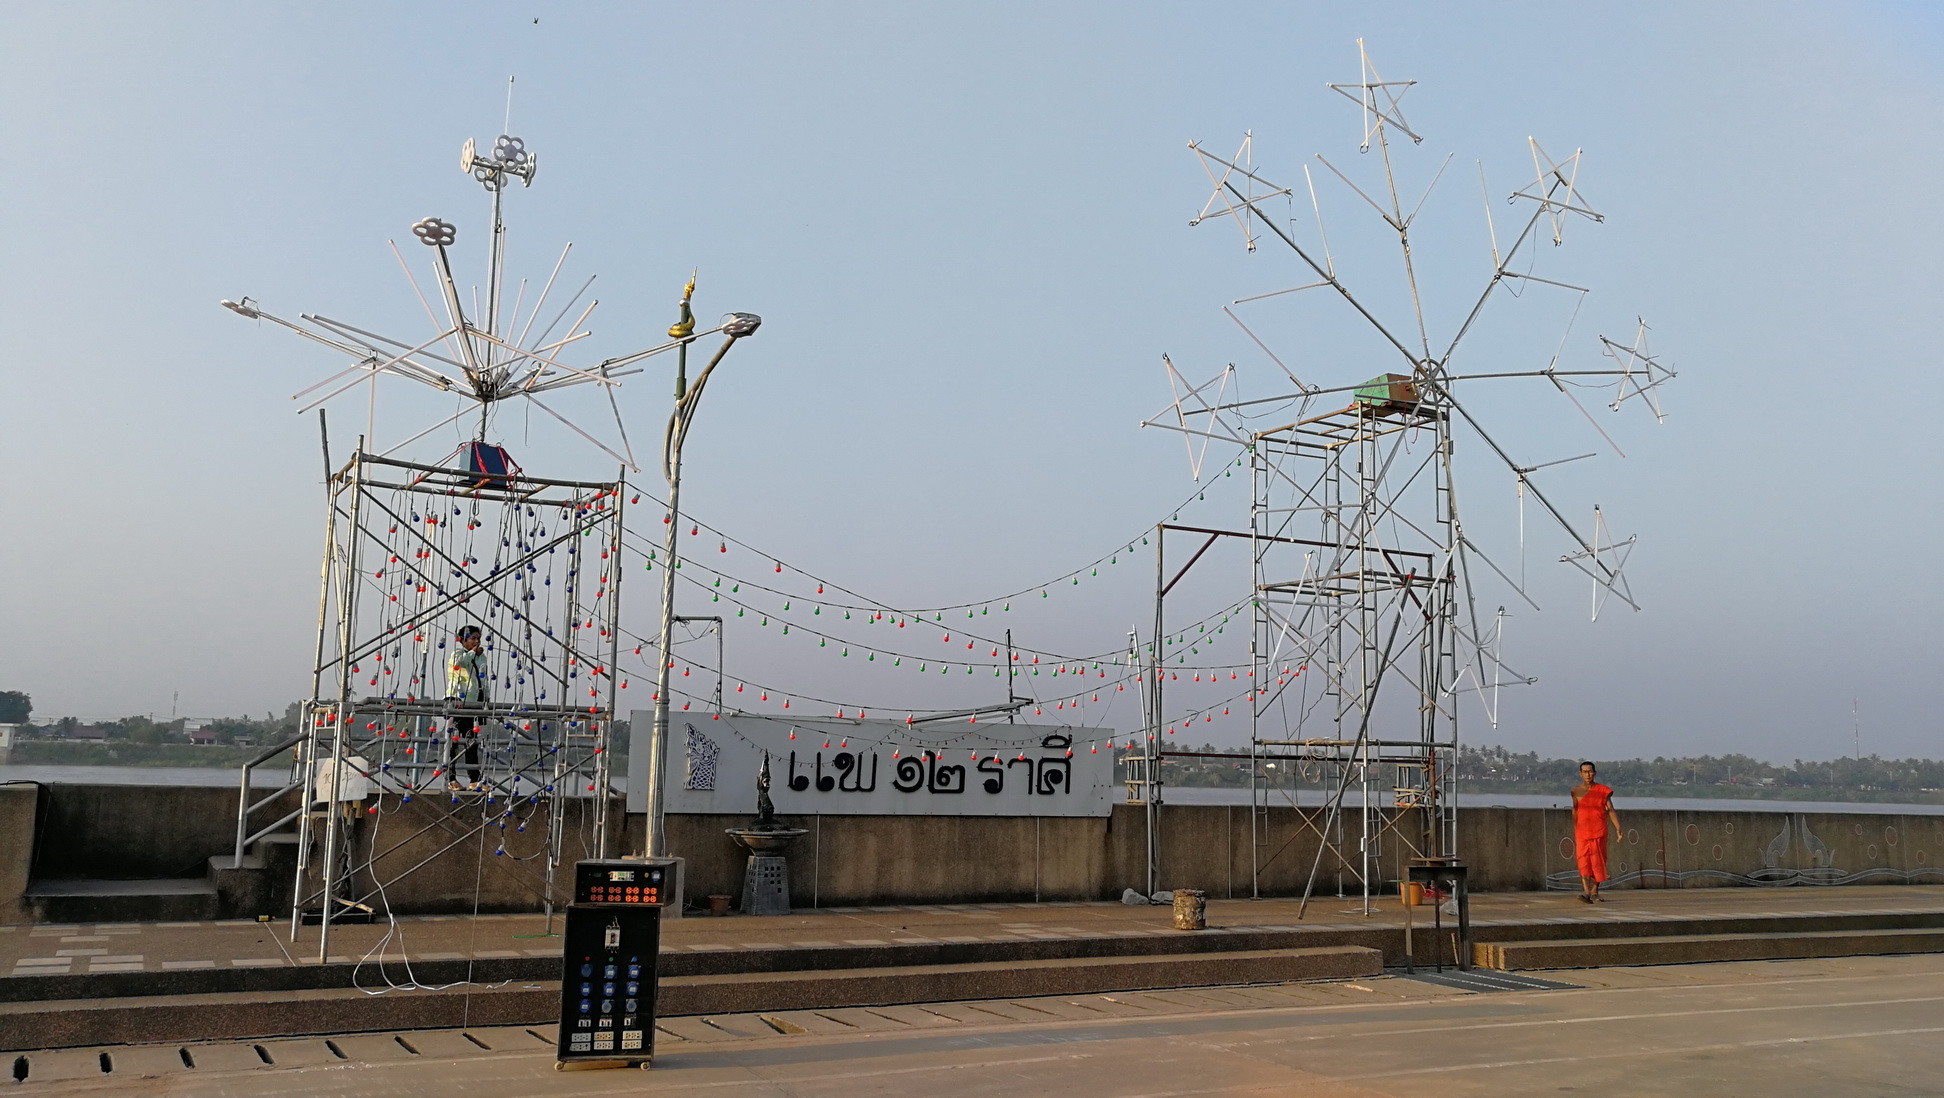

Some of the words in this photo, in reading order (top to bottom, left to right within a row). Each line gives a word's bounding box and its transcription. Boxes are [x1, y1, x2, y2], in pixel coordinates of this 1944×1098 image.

[789, 750, 878, 792] แพ
[893, 750, 966, 794] ๑๒
[977, 734, 1073, 795] ราศี
